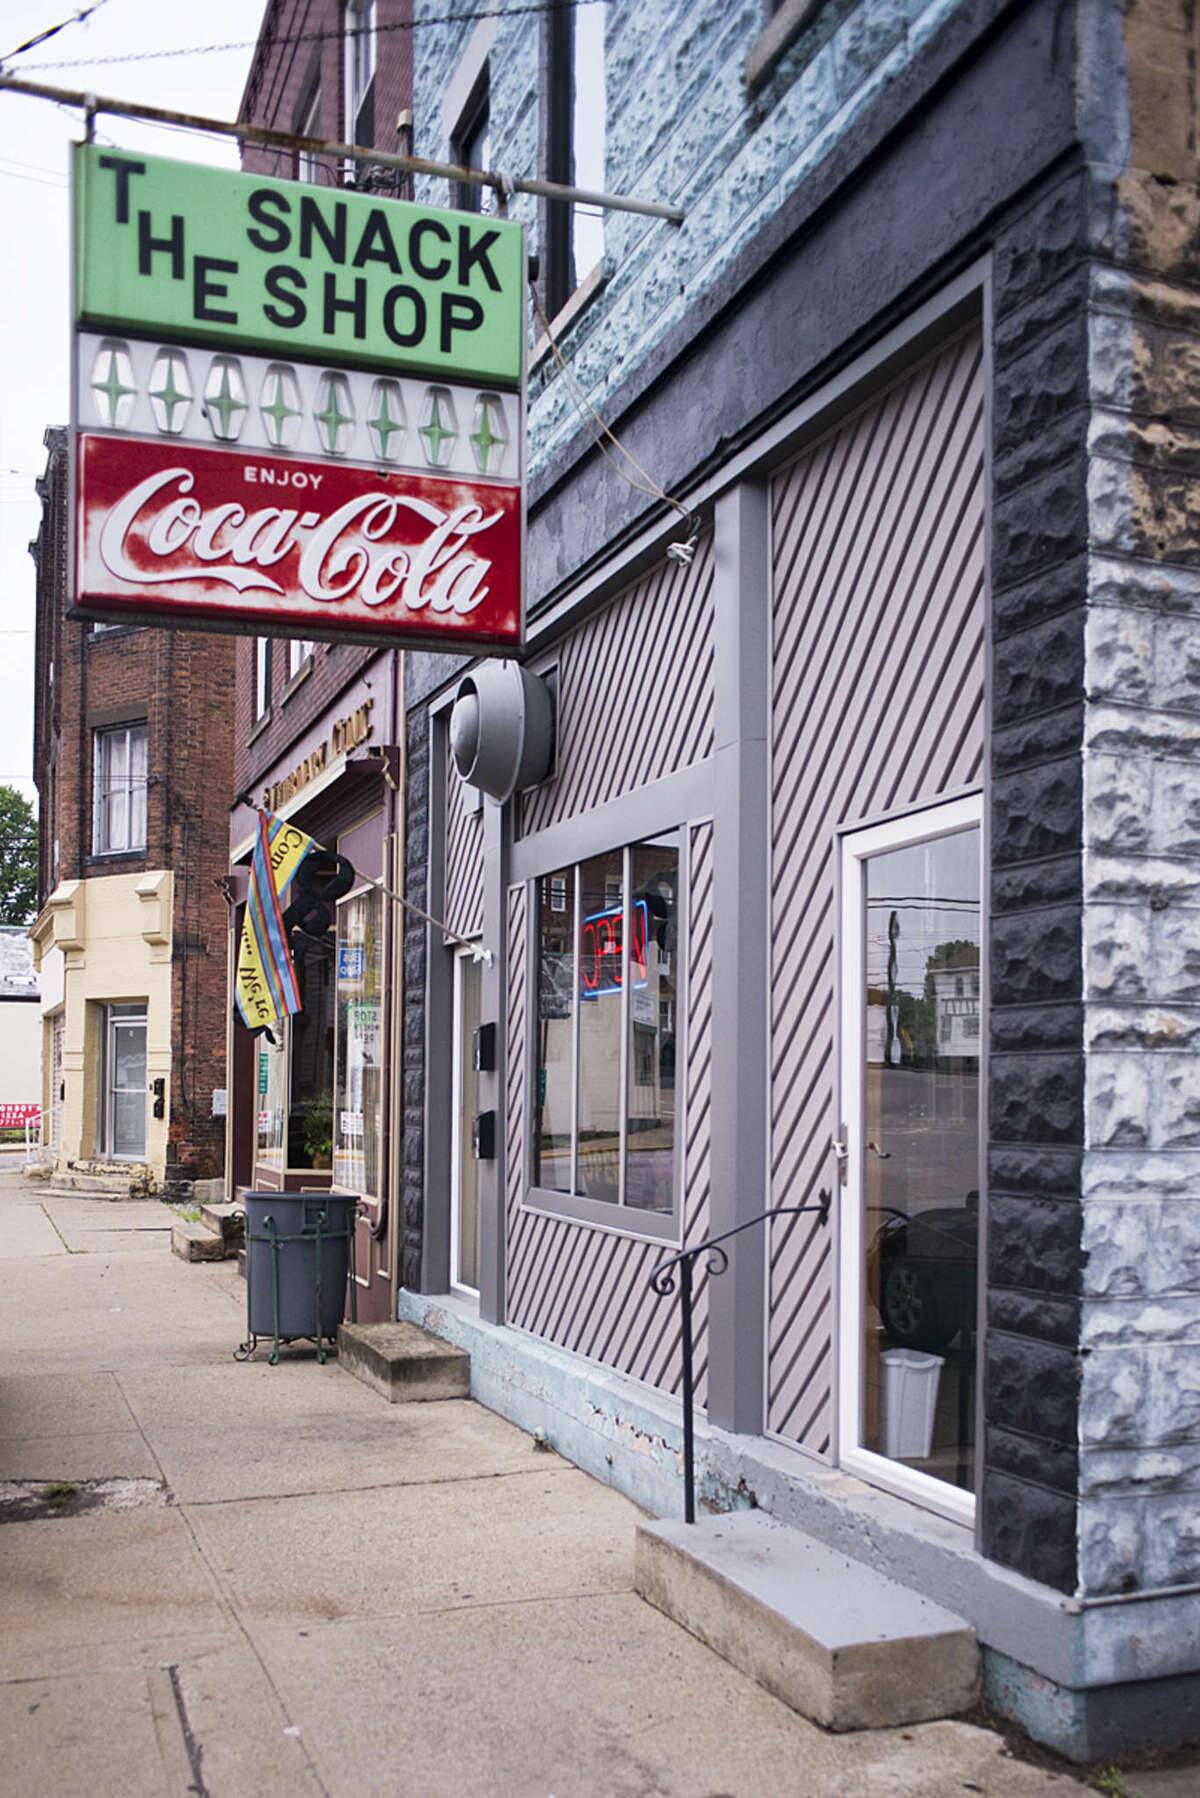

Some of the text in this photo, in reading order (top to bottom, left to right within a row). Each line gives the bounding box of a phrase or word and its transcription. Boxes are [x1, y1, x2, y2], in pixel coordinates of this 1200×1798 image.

[100, 156, 239, 325] THE
[246, 189, 503, 292] SNACK
[262, 265, 485, 352] SHOP
[243, 466, 323, 490] ENJOY
[101, 467, 504, 615] Coca-Cola
